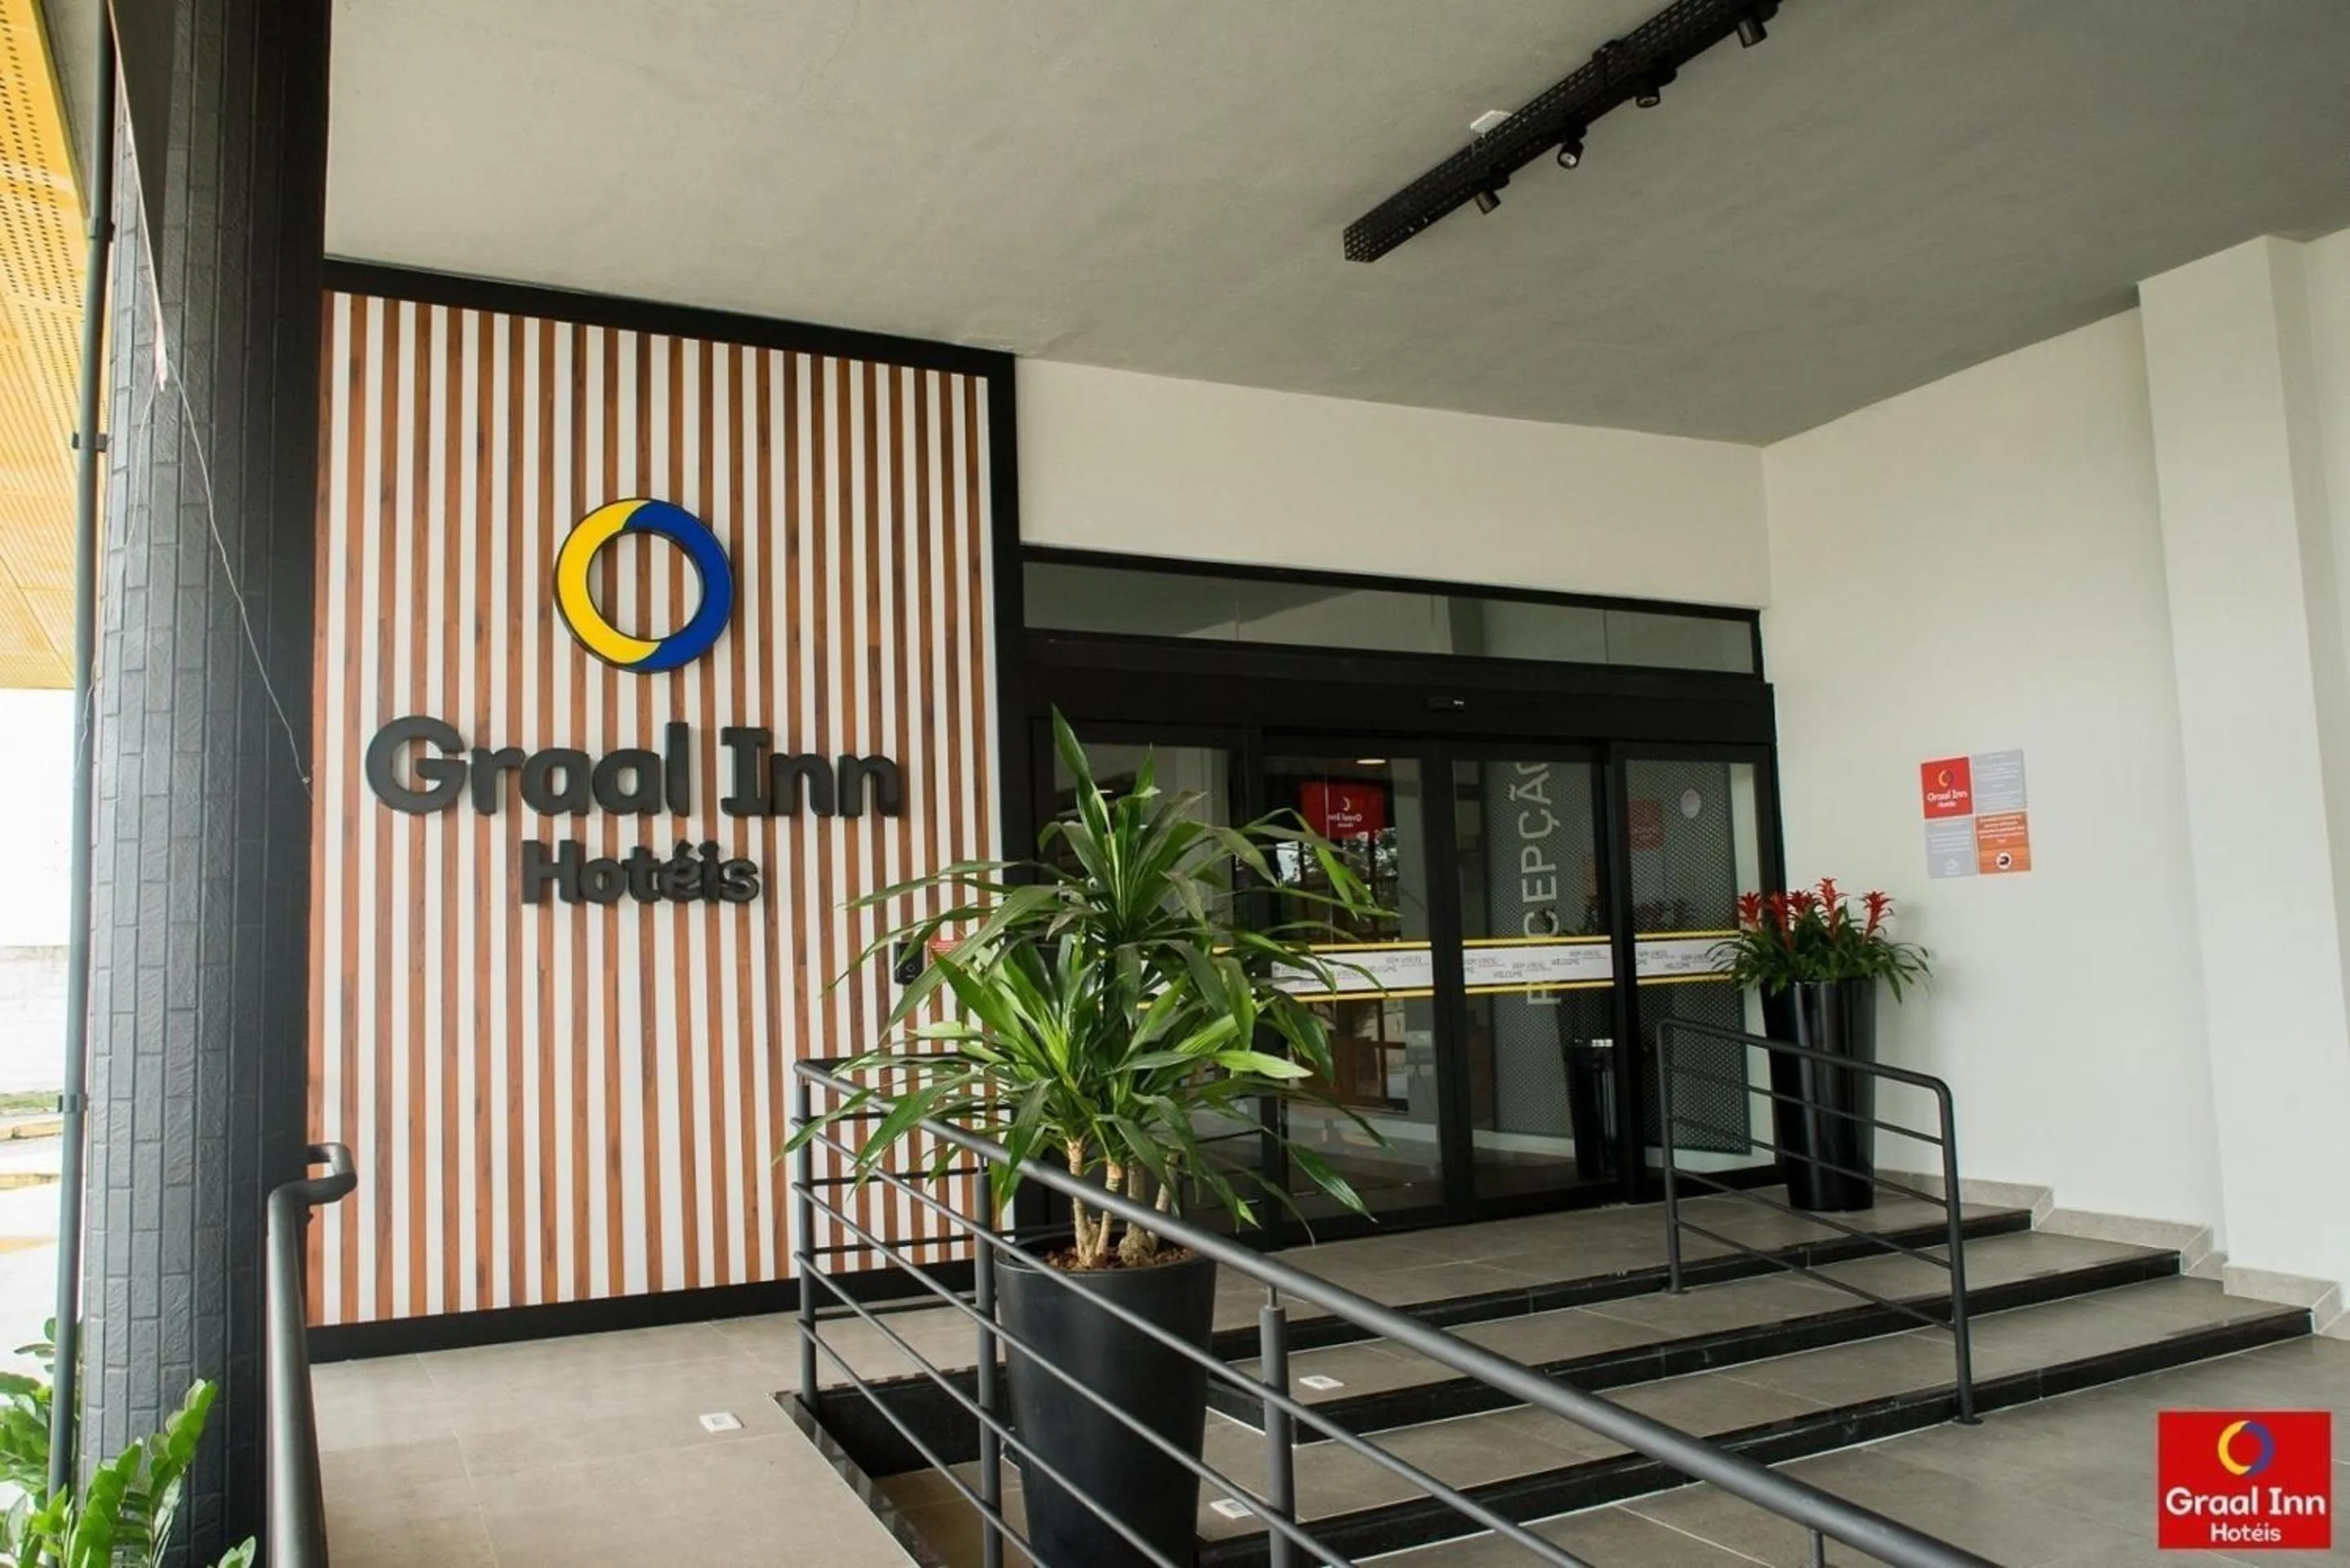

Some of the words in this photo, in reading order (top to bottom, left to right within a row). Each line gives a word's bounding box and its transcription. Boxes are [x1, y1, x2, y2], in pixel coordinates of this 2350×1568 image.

[366, 715, 691, 816] Graal
[721, 727, 902, 817] Inn
[522, 839, 760, 906] Hotéis
